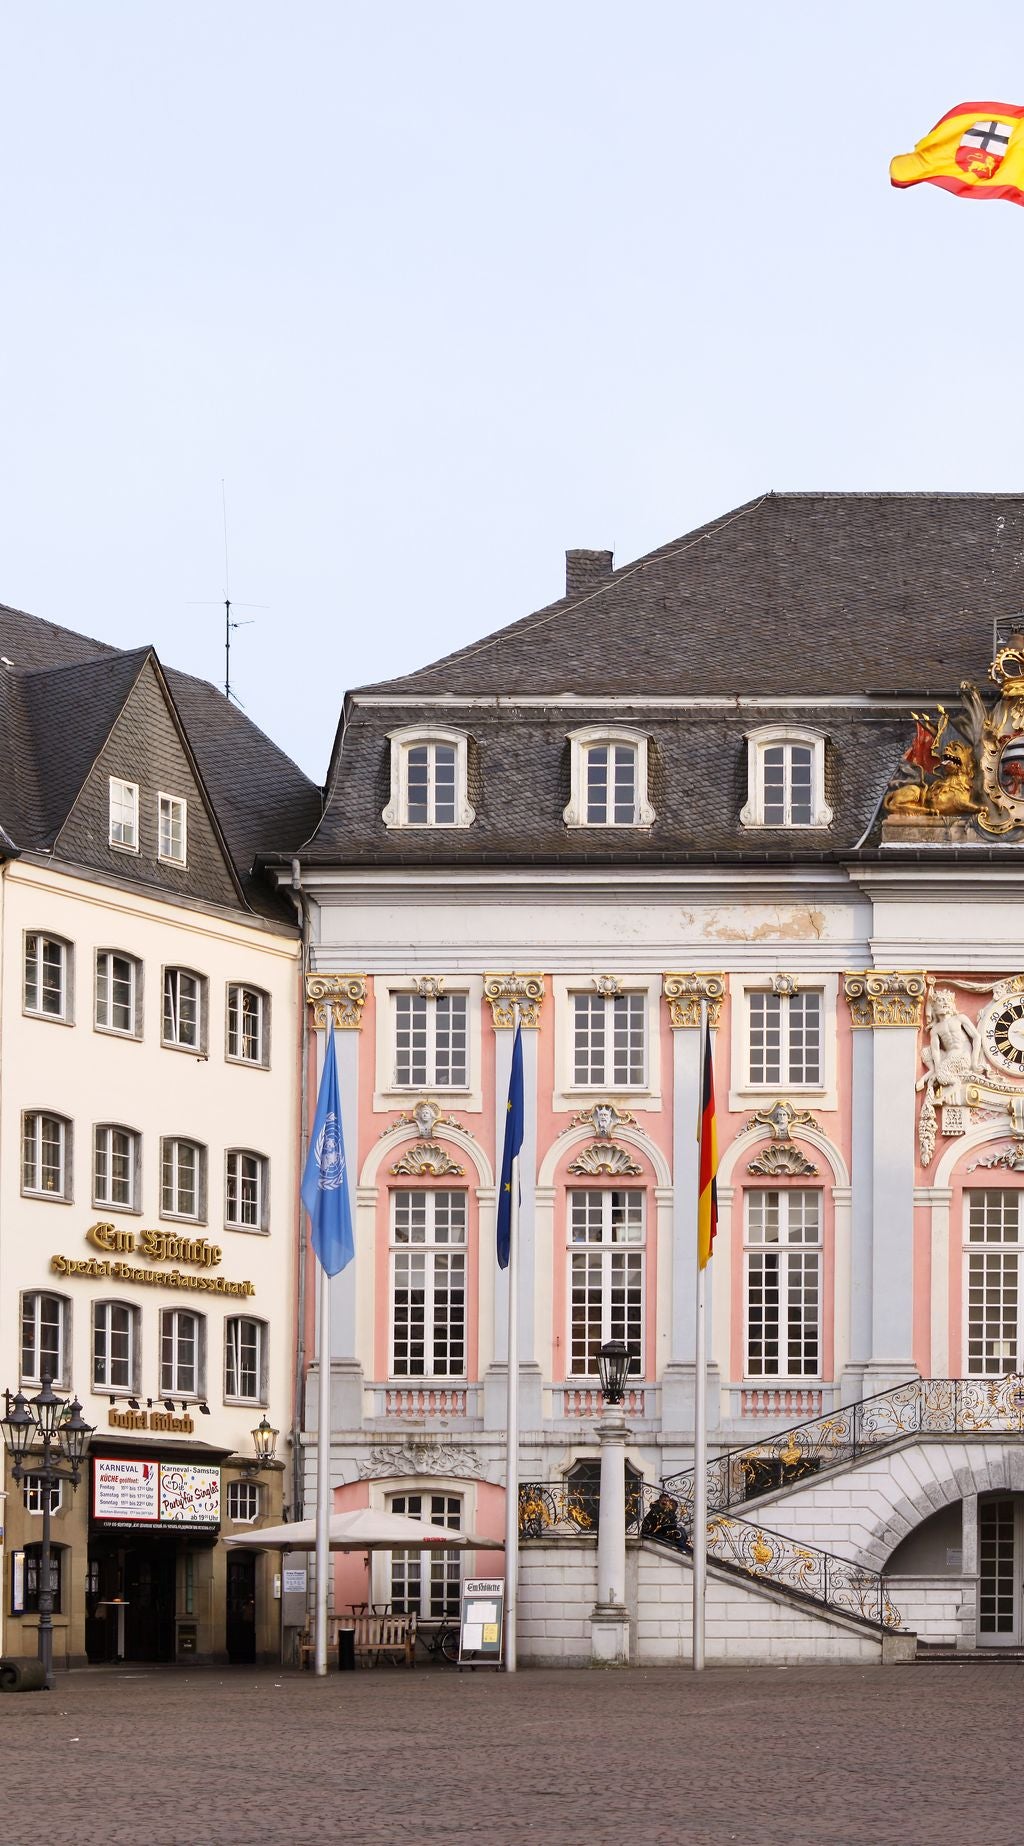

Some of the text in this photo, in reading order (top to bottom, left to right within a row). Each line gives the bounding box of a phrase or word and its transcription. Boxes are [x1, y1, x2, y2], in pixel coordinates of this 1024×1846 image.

[1002, 1001, 1013, 1009] 55
[990, 1012, 999, 1022] 50
[986, 1029, 994, 1040] 45
[990, 1046, 999, 1056] 40
[1002, 1059, 1012, 1068] 35
[108, 1408, 194, 1433] Gaffel Kölsch
[100, 1464, 139, 1473] KARNEVAL
[100, 1474, 119, 1482] KÜCHE
[195, 1482, 219, 1500] Singles
[162, 1498, 187, 1512] Party
